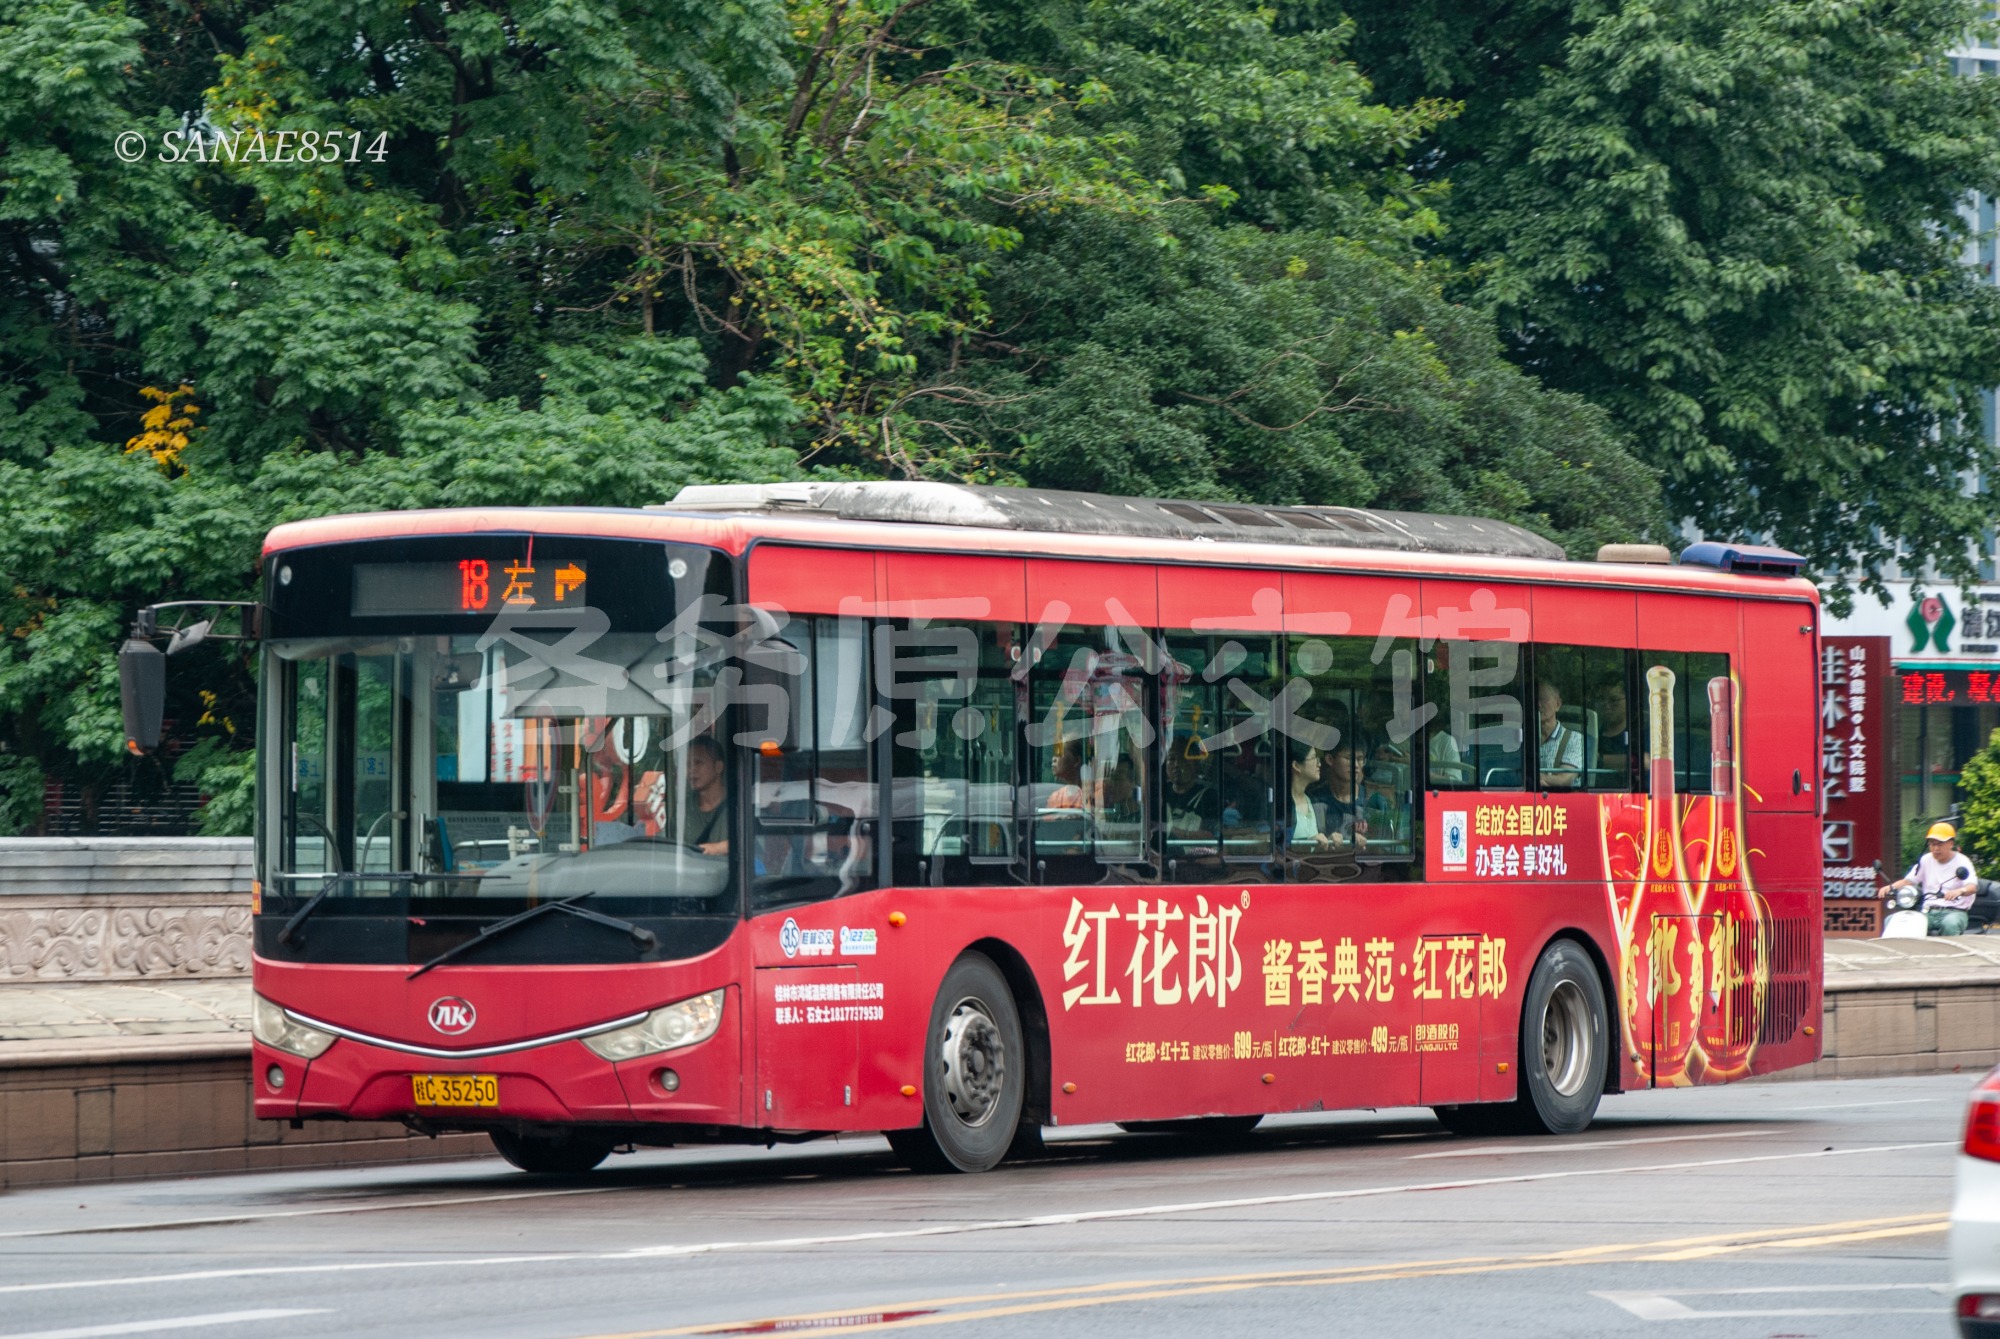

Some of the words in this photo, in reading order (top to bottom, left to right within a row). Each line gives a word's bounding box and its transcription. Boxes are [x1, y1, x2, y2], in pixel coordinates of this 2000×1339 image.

[459, 559, 489, 609] 18
[501, 559, 536, 604] 左
[1475, 804, 1568, 837] 绽放全国20年
[1475, 844, 1520, 877] 办宴会
[1523, 844, 1568, 877] 享好礼
[1061, 894, 1244, 1012] 红花郎
[1261, 933, 1508, 1007] 酱香典范·红花郎
[1415, 1023, 1459, 1041] 郎酒股份
